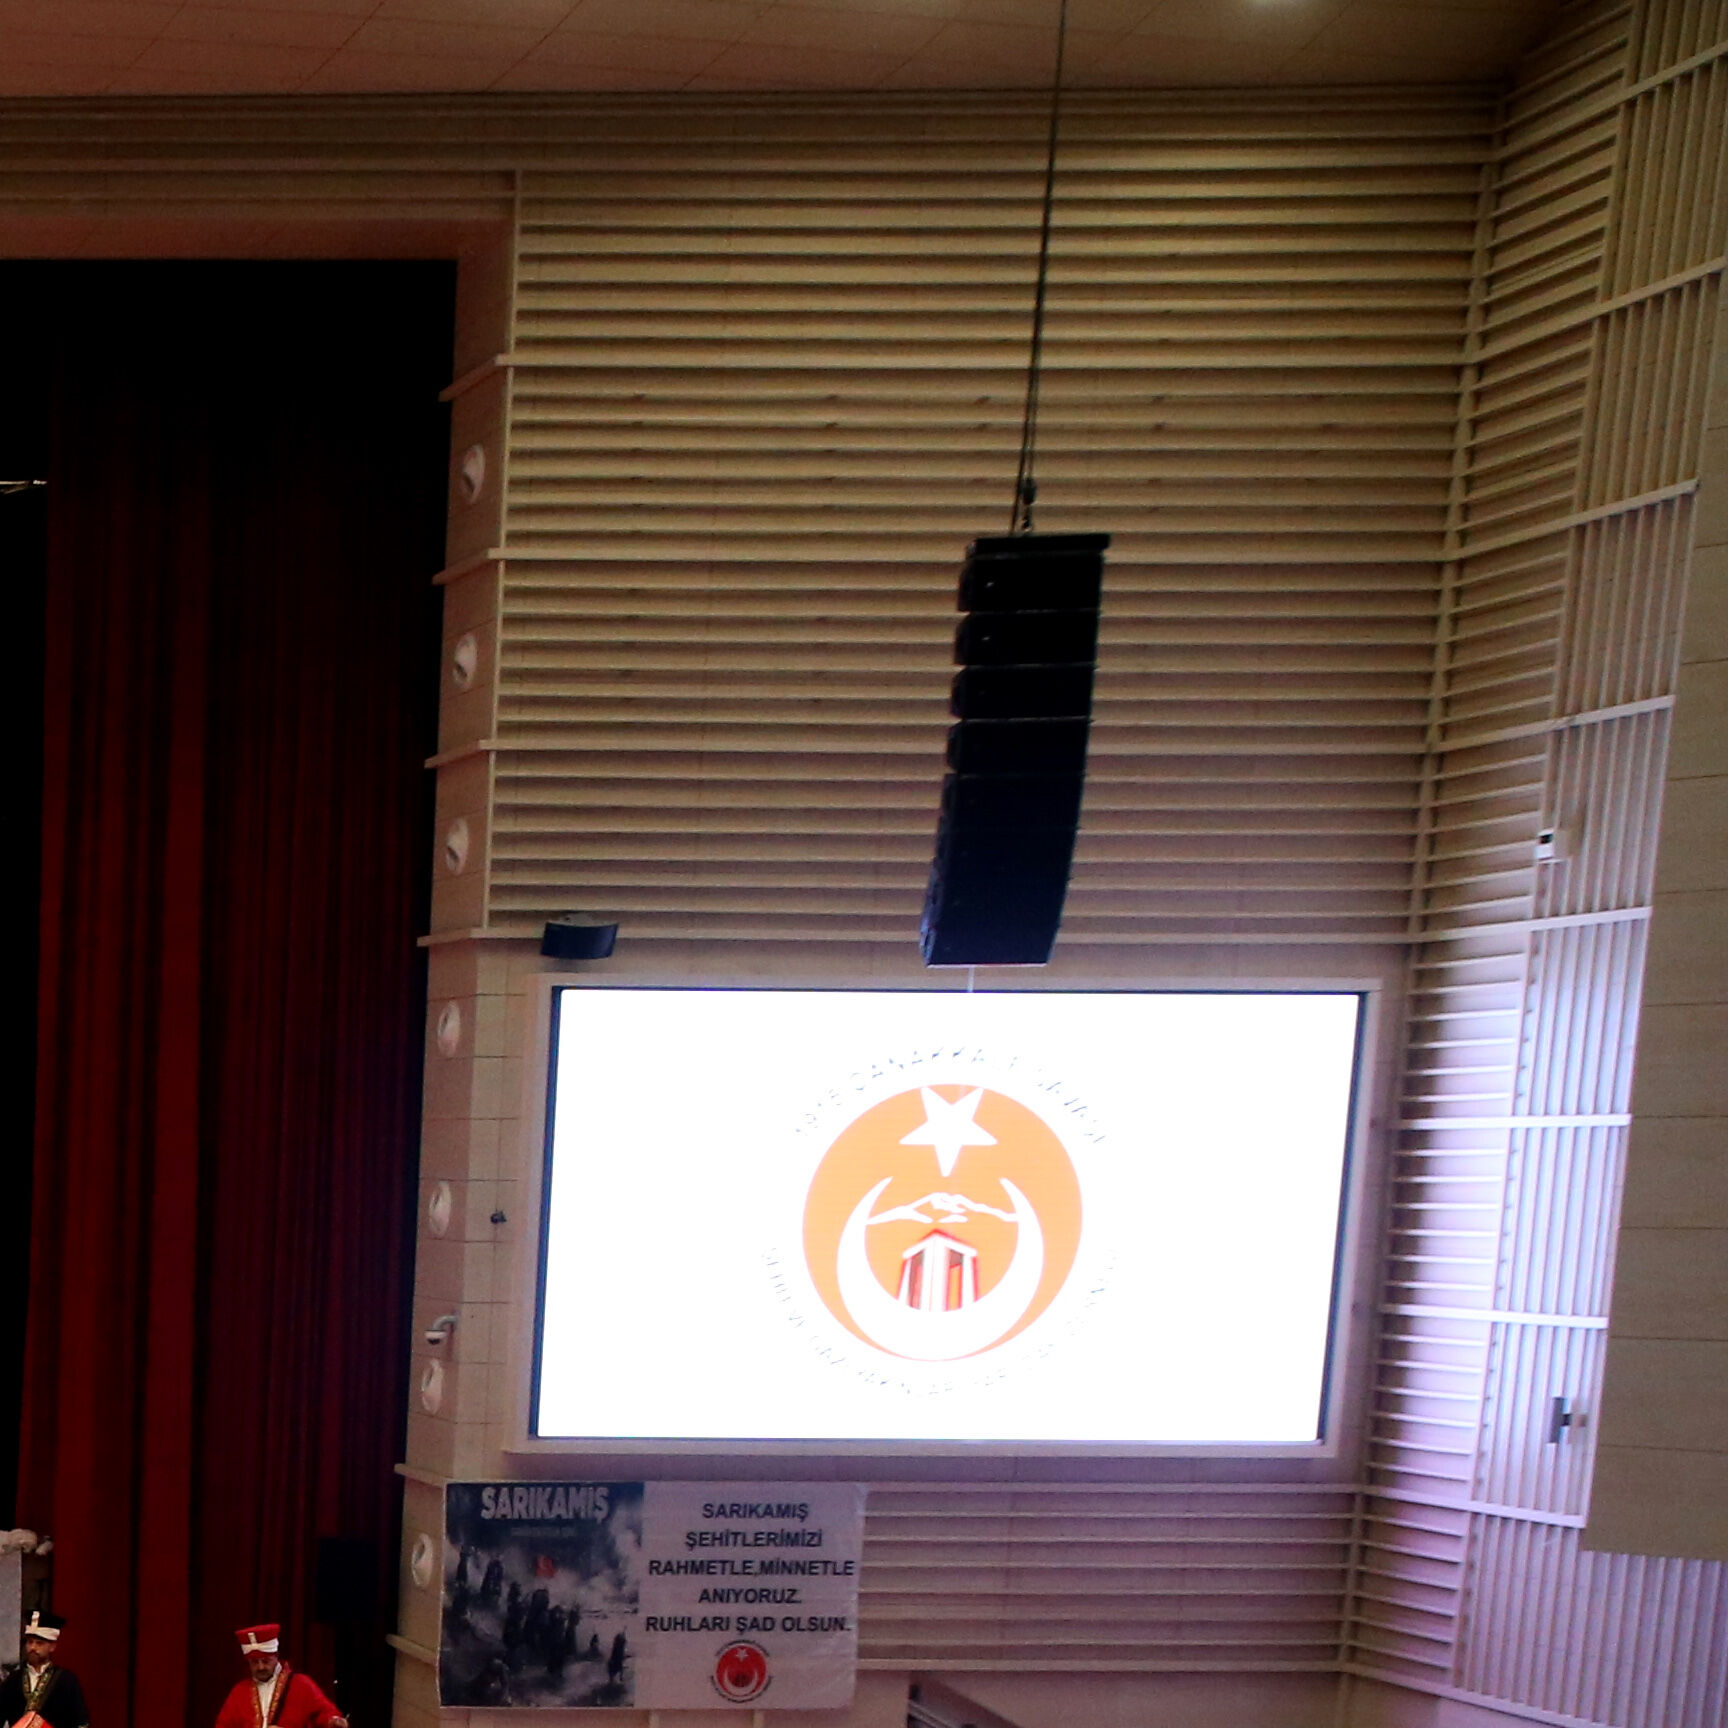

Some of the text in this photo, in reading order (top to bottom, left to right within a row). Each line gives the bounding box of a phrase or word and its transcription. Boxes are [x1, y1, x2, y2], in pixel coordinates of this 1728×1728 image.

[480, 1486, 609, 1524] SARIKAMIŞ
[702, 1502, 809, 1522] SARIKAMIŞ
[685, 1528, 823, 1551] ŞEHİTLERİMİZİ
[698, 1587, 801, 1604] ANIYORUZ.
[645, 1615, 730, 1632] RUHLARI
[736, 1615, 775, 1636] ŞAD
